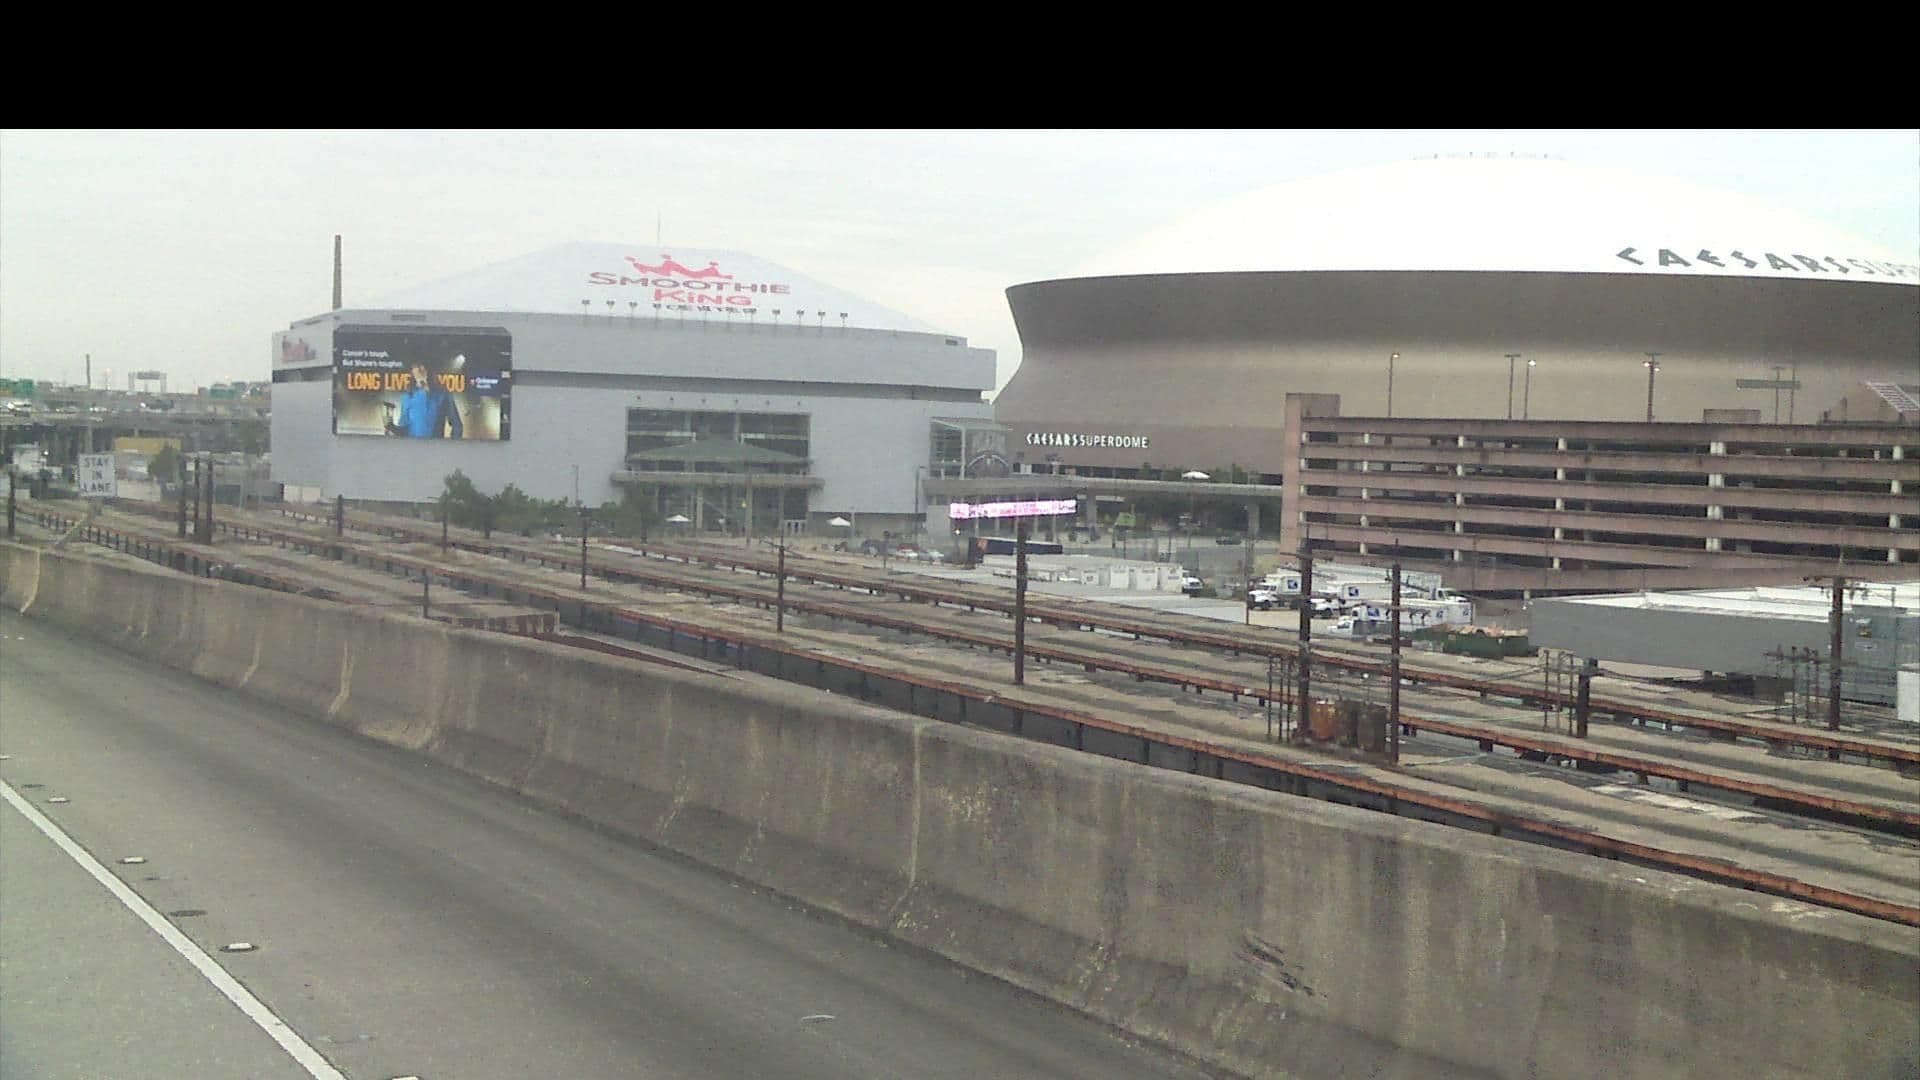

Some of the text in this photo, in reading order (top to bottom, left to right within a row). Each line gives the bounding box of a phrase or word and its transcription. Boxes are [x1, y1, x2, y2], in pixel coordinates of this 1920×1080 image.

[1616, 247, 1849, 274] CAESARS
[588, 271, 791, 294] SMOOTHIE
[347, 372, 381, 391] LONG
[1026, 432, 1149, 448] CAESARS SUPERDOME
[84, 456, 109, 468] STAY
[92, 470, 103, 480] IN
[82, 482, 111, 492] LANE
